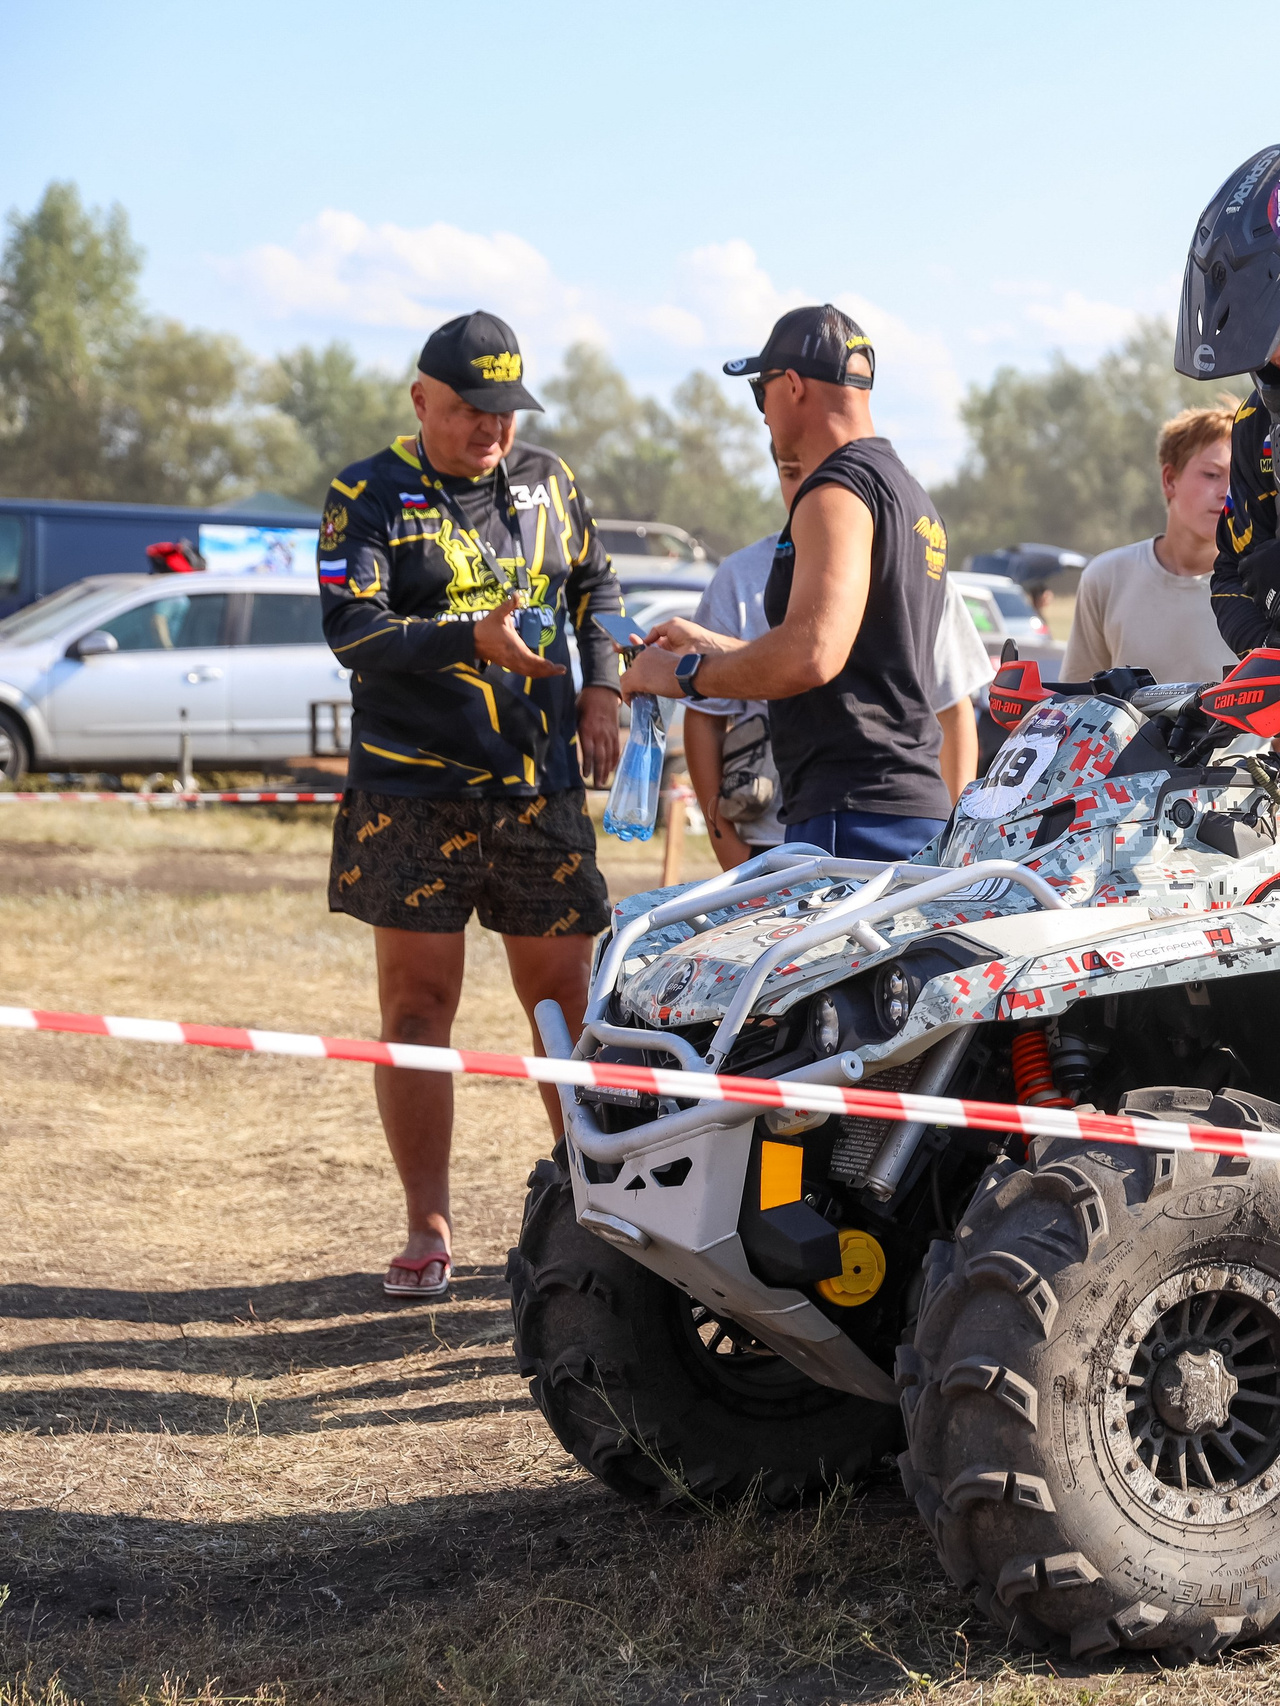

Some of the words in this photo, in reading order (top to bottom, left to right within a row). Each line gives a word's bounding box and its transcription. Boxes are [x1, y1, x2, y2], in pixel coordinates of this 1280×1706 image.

[509, 484, 551, 511] 34
[1213, 689, 1266, 711] can-am
[980, 747, 1038, 790] 119
[356, 812, 392, 843] FILA
[439, 831, 478, 858] FILA
[338, 865, 363, 893] FIL
[552, 852, 582, 885] FILA
[404, 878, 447, 908] FILA
[1182, 1186, 1239, 1215] ITP
[1172, 1575, 1269, 1608] LITE
